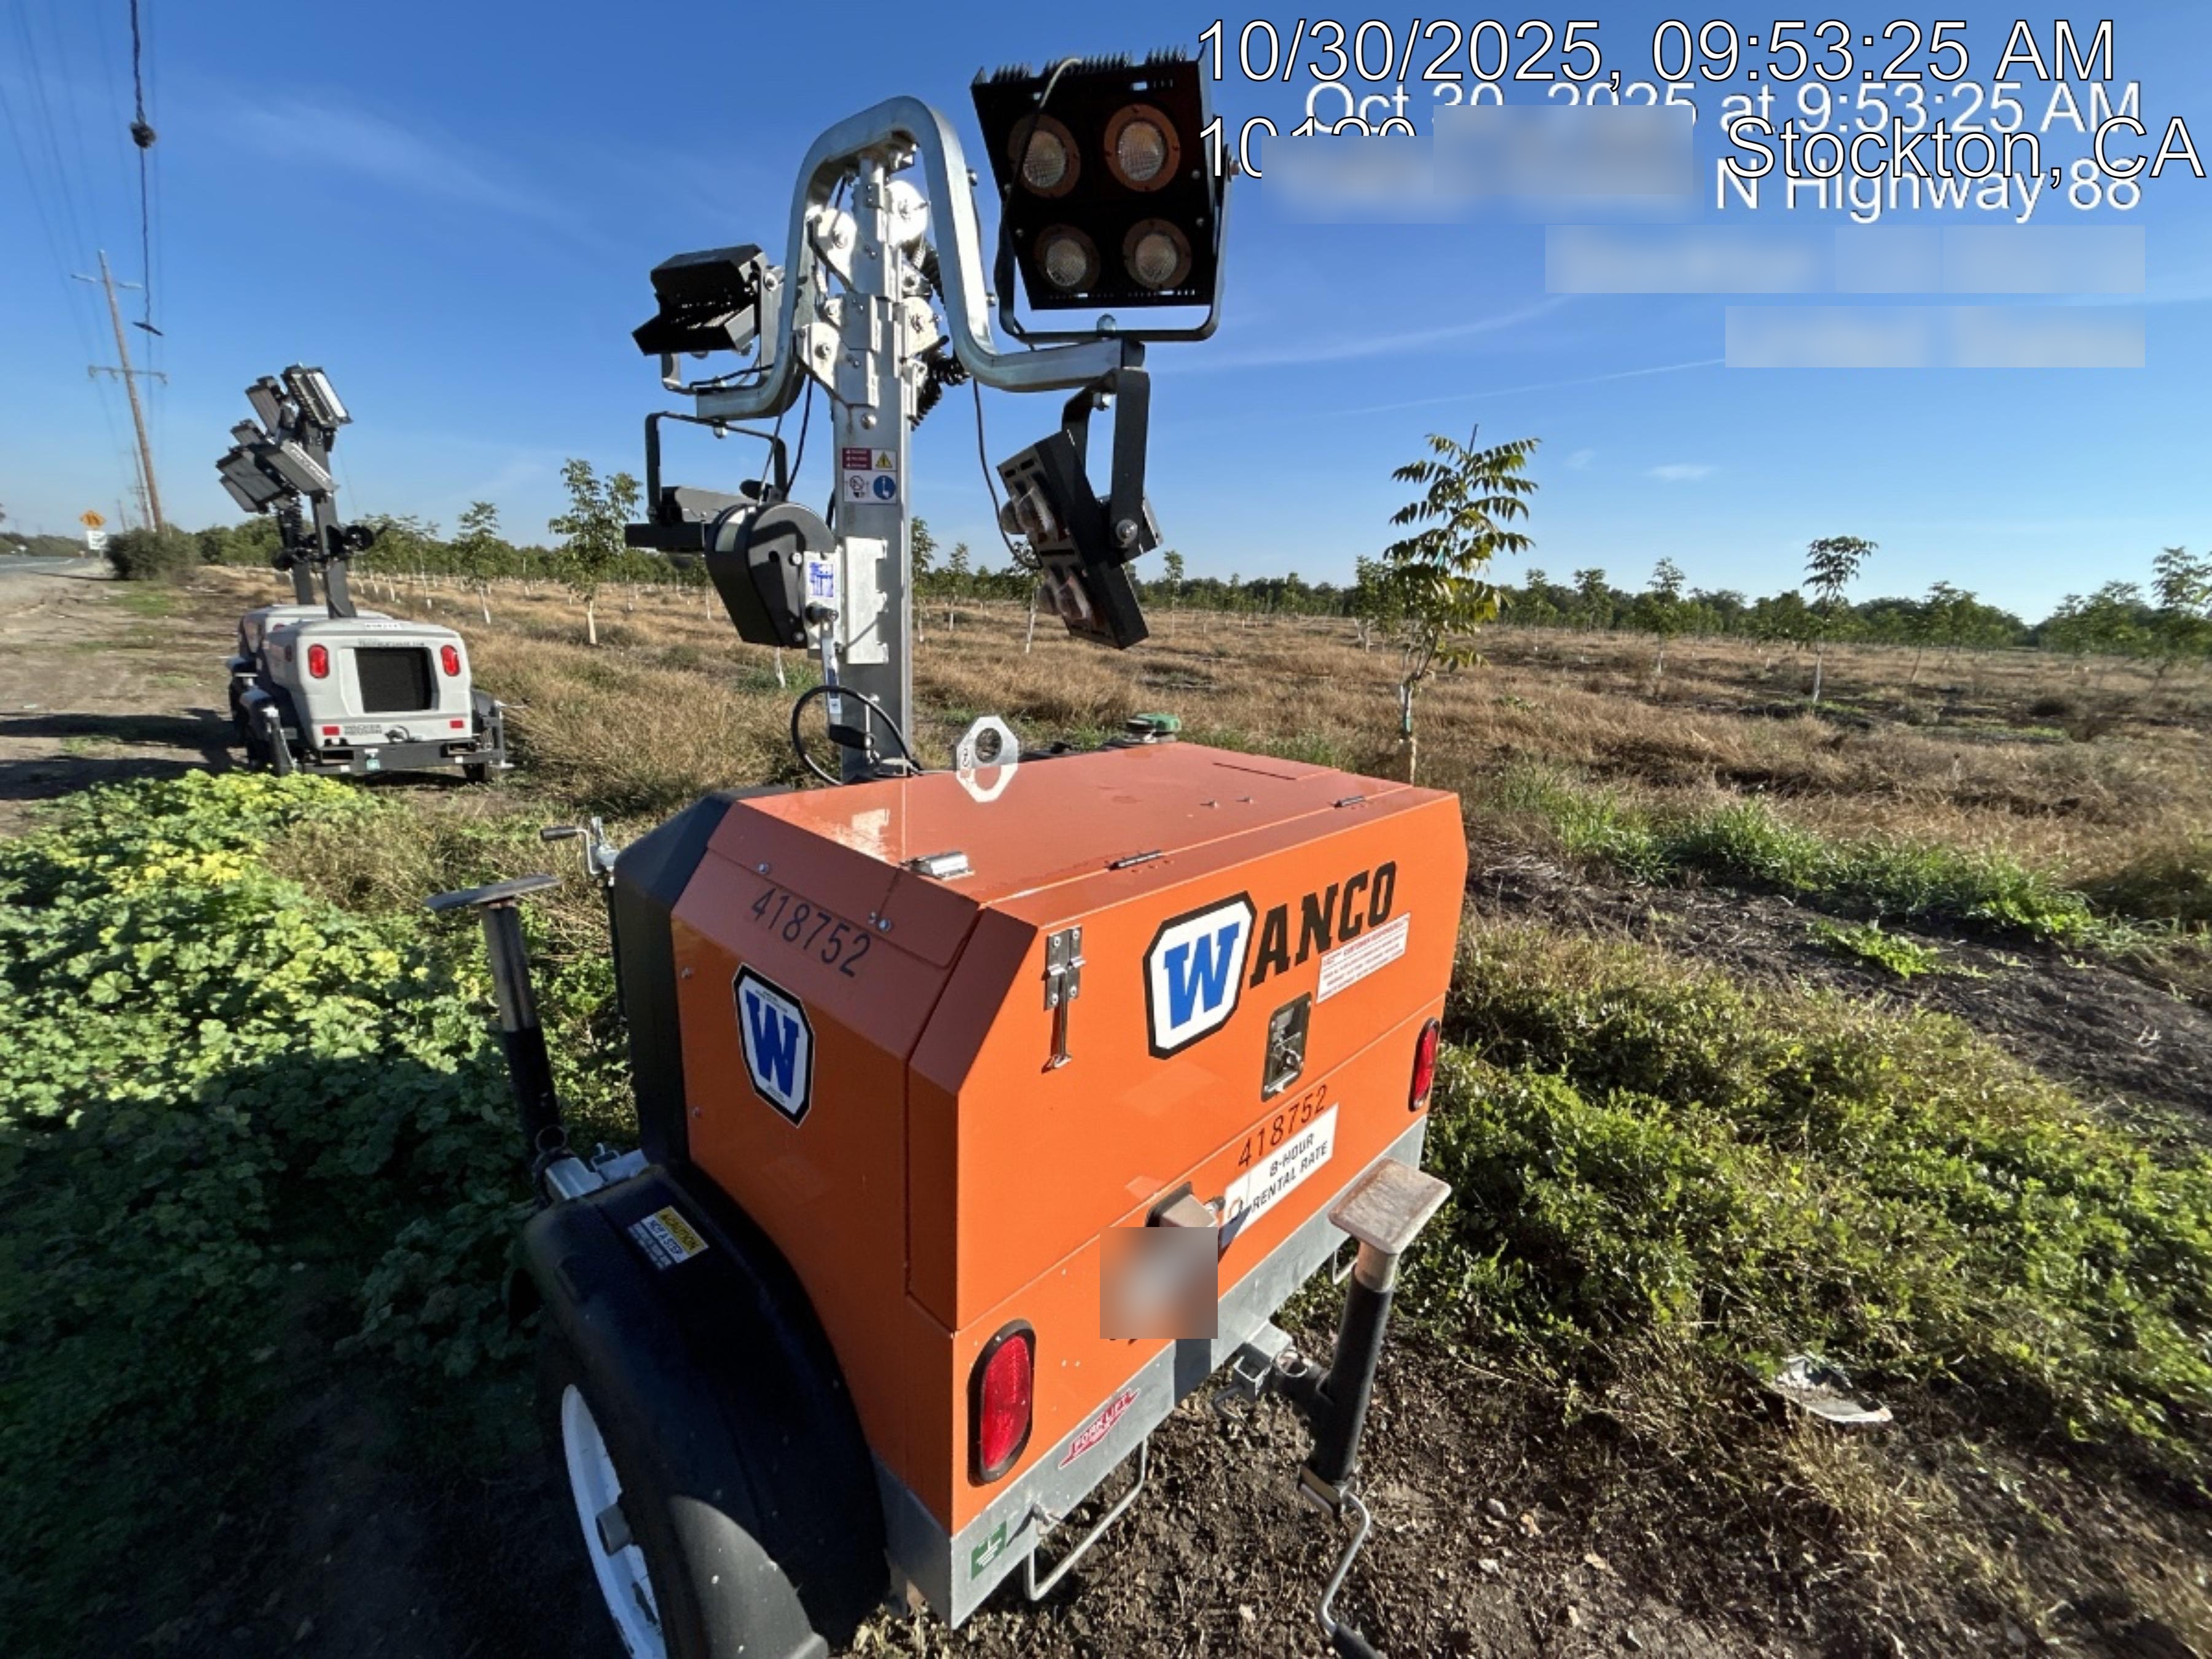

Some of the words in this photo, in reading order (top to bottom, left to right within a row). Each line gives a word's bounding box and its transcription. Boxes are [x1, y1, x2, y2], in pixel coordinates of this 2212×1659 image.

[751, 888, 871, 978] 418752
[745, 989, 799, 1099] W
[1238, 1084, 1328, 1167] 418752
[1269, 1132, 1315, 1177] 8-HOUR
[1252, 1167, 1296, 1211] RENTAL
[1300, 1140, 1328, 1173] RATE
